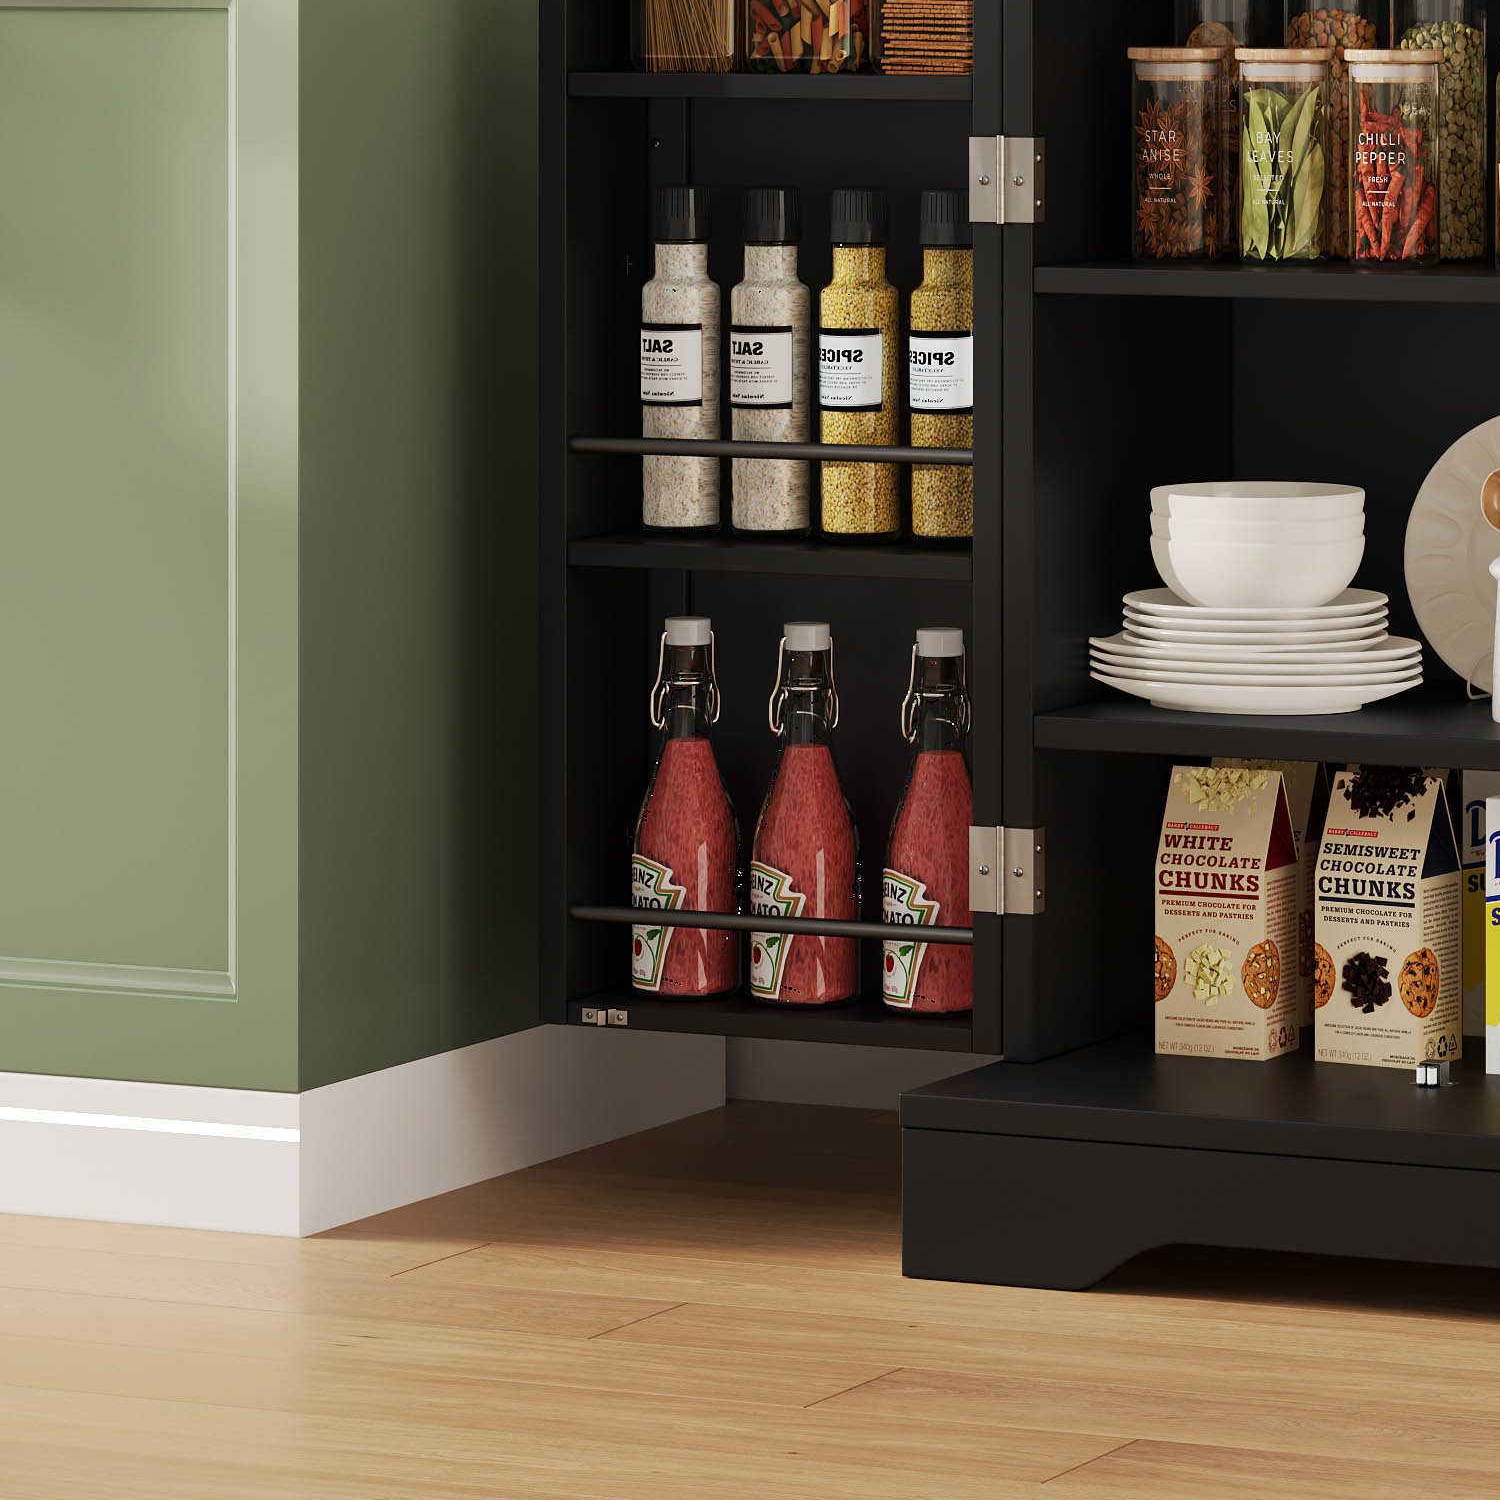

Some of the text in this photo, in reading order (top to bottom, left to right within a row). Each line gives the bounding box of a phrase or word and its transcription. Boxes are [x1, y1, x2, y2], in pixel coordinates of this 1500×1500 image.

[1145, 131, 1176, 142] STAR
[1257, 132, 1281, 144] BAY
[1358, 132, 1400, 146] CHILLI
[1142, 149, 1180, 162] ANISE
[1248, 151, 1294, 163] LEAVES
[1356, 152, 1406, 165] PEPPER
[1368, 176, 1388, 184] FRESH
[1164, 834, 1233, 851] WHITE
[1323, 843, 1420, 861] SEMISWEET
[1160, 853, 1261, 869] CHOCOLATE
[1320, 860, 1417, 877] CHOCOLATE
[632, 866, 655, 888] EINZ
[751, 872, 774, 895] EINZ
[1159, 870, 1259, 892] CHUNKS
[883, 882, 907, 902] EINZ
[1318, 877, 1415, 900] CHUNKS
[1162, 900, 1195, 908] PREMIUM
[1198, 901, 1240, 910] CHOCOLATE
[1165, 909, 1200, 918] DESSERTS
[1219, 912, 1254, 920] PASTRIES
